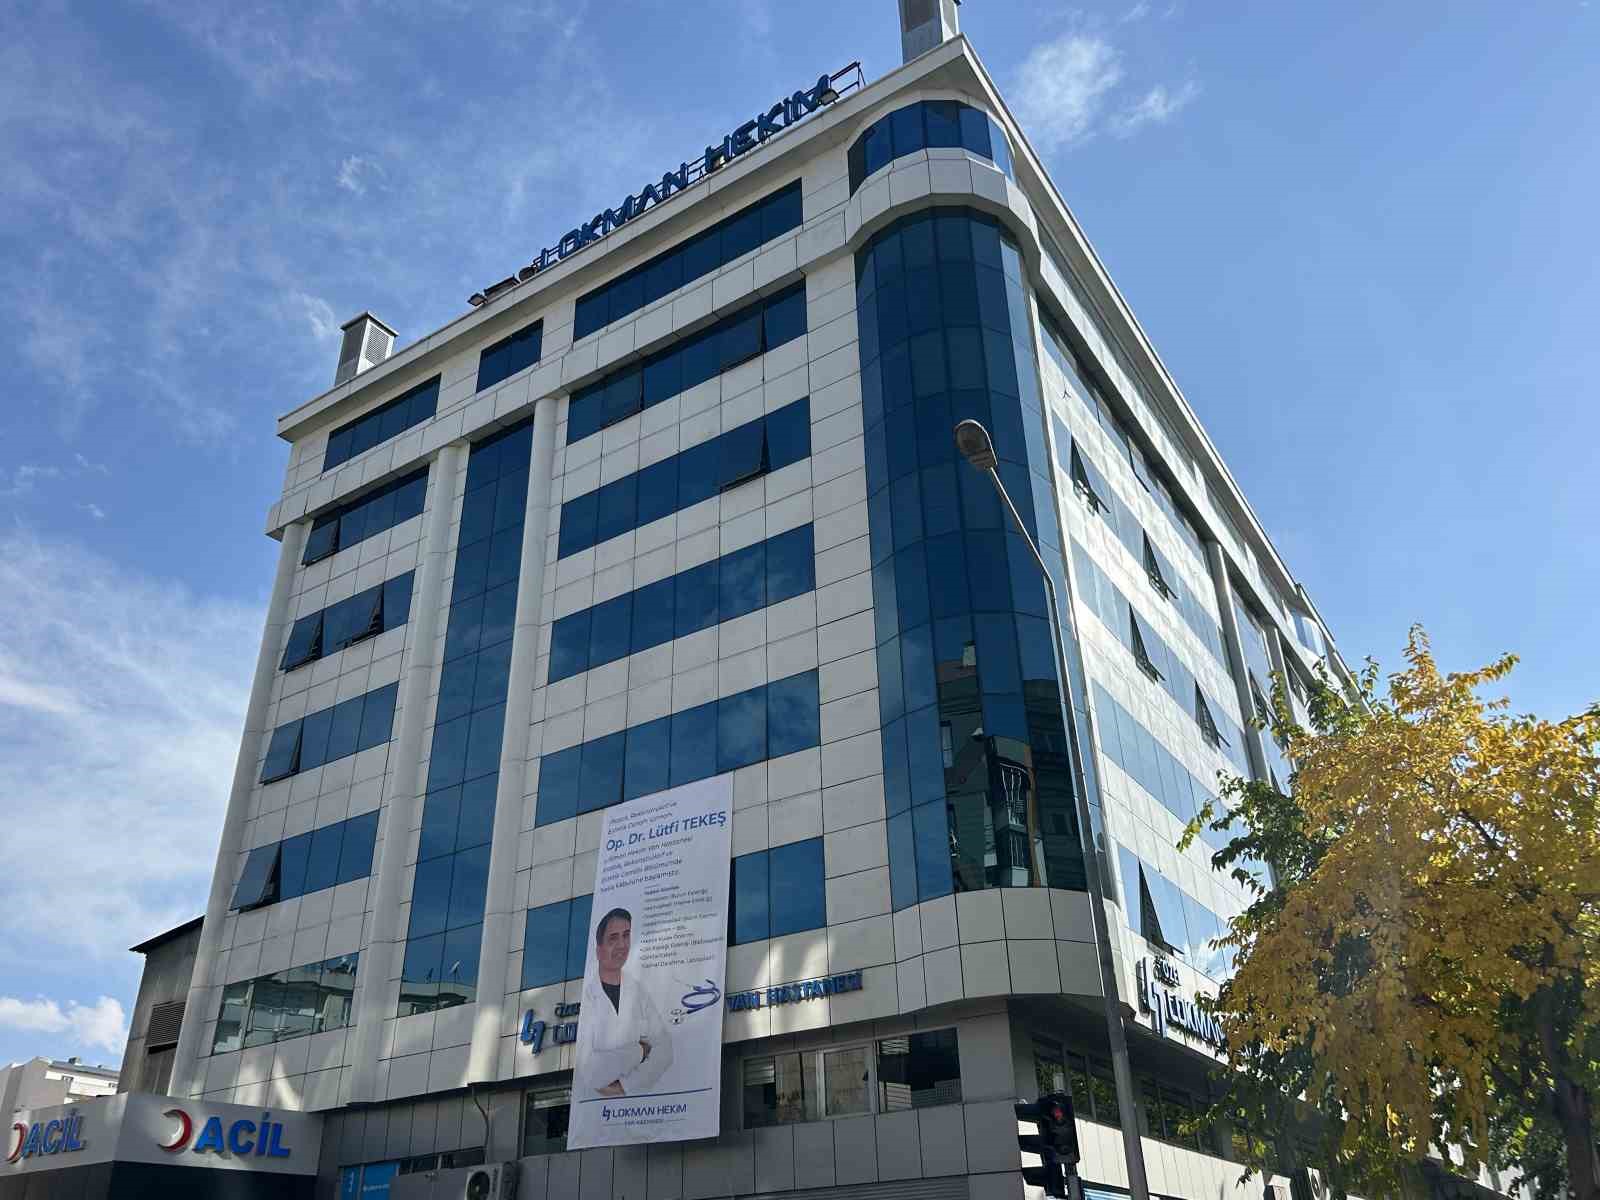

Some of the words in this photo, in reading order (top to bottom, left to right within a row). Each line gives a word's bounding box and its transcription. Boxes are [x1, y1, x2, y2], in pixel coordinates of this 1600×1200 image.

[537, 160, 690, 270] LOKMAN
[605, 839, 625, 851] Op.
[628, 832, 646, 846] Dr.
[648, 820, 681, 840] Lütfi
[681, 811, 727, 832] TEKEŞ
[21, 1110, 82, 1159] ACİL
[192, 1111, 291, 1157] ACİL
[612, 1105, 656, 1118] LOKMAN
